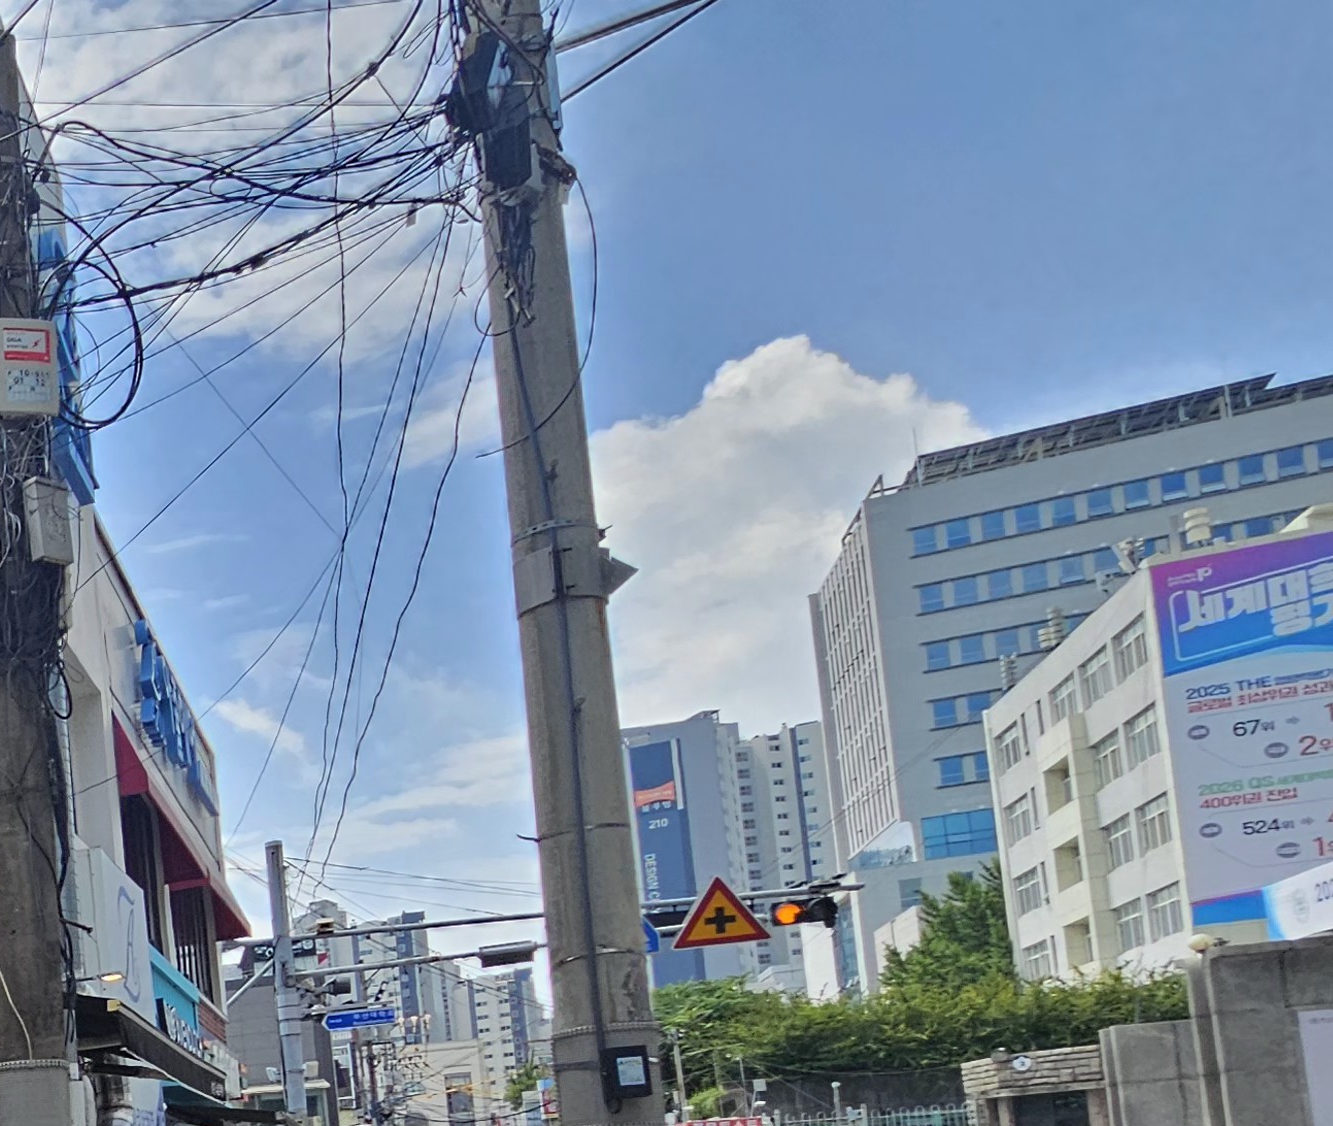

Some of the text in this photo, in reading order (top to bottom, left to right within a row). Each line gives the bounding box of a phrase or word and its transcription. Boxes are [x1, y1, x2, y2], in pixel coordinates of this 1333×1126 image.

[1186, 682, 1231, 700] 2025
[1235, 675, 1272, 691] THE
[1238, 686, 1298, 706] 최상위권
[1198, 779, 1244, 796] 2026
[1248, 775, 1274, 788] QS
[1266, 787, 1298, 802] 진입
[648, 818, 668, 829] 210
[644, 853, 660, 890] DESIGN
